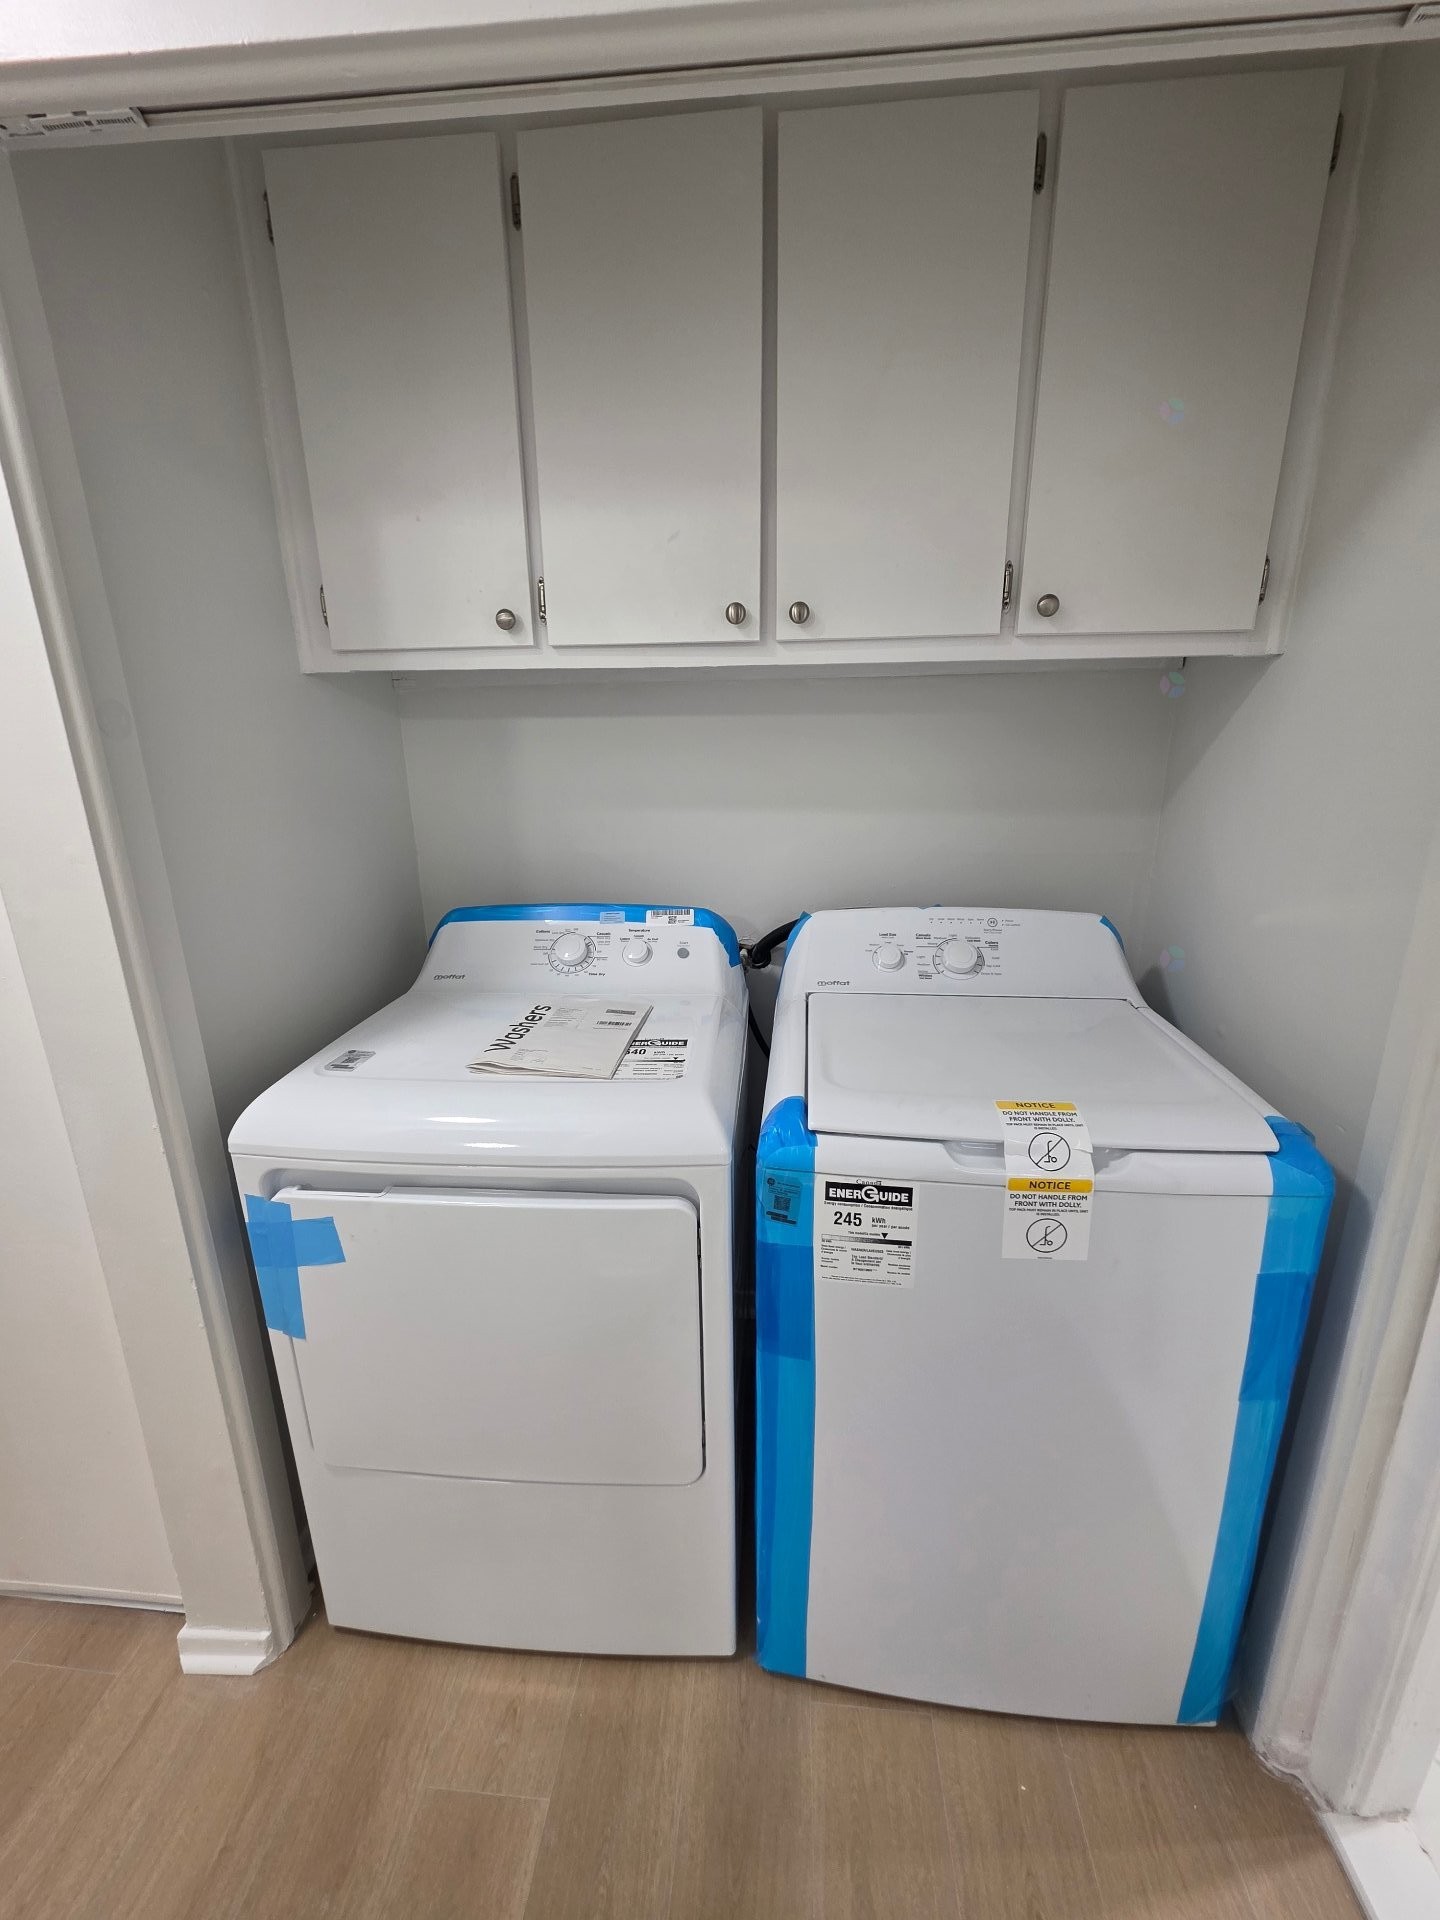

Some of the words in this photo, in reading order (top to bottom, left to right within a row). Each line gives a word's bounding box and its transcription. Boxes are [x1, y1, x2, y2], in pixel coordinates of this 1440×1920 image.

[484, 1005, 551, 1052] Washers
[1029, 1181, 1071, 1189] NOTICE
[829, 1186, 909, 1202] ENERGUIDE
[834, 1211, 862, 1227] 245
